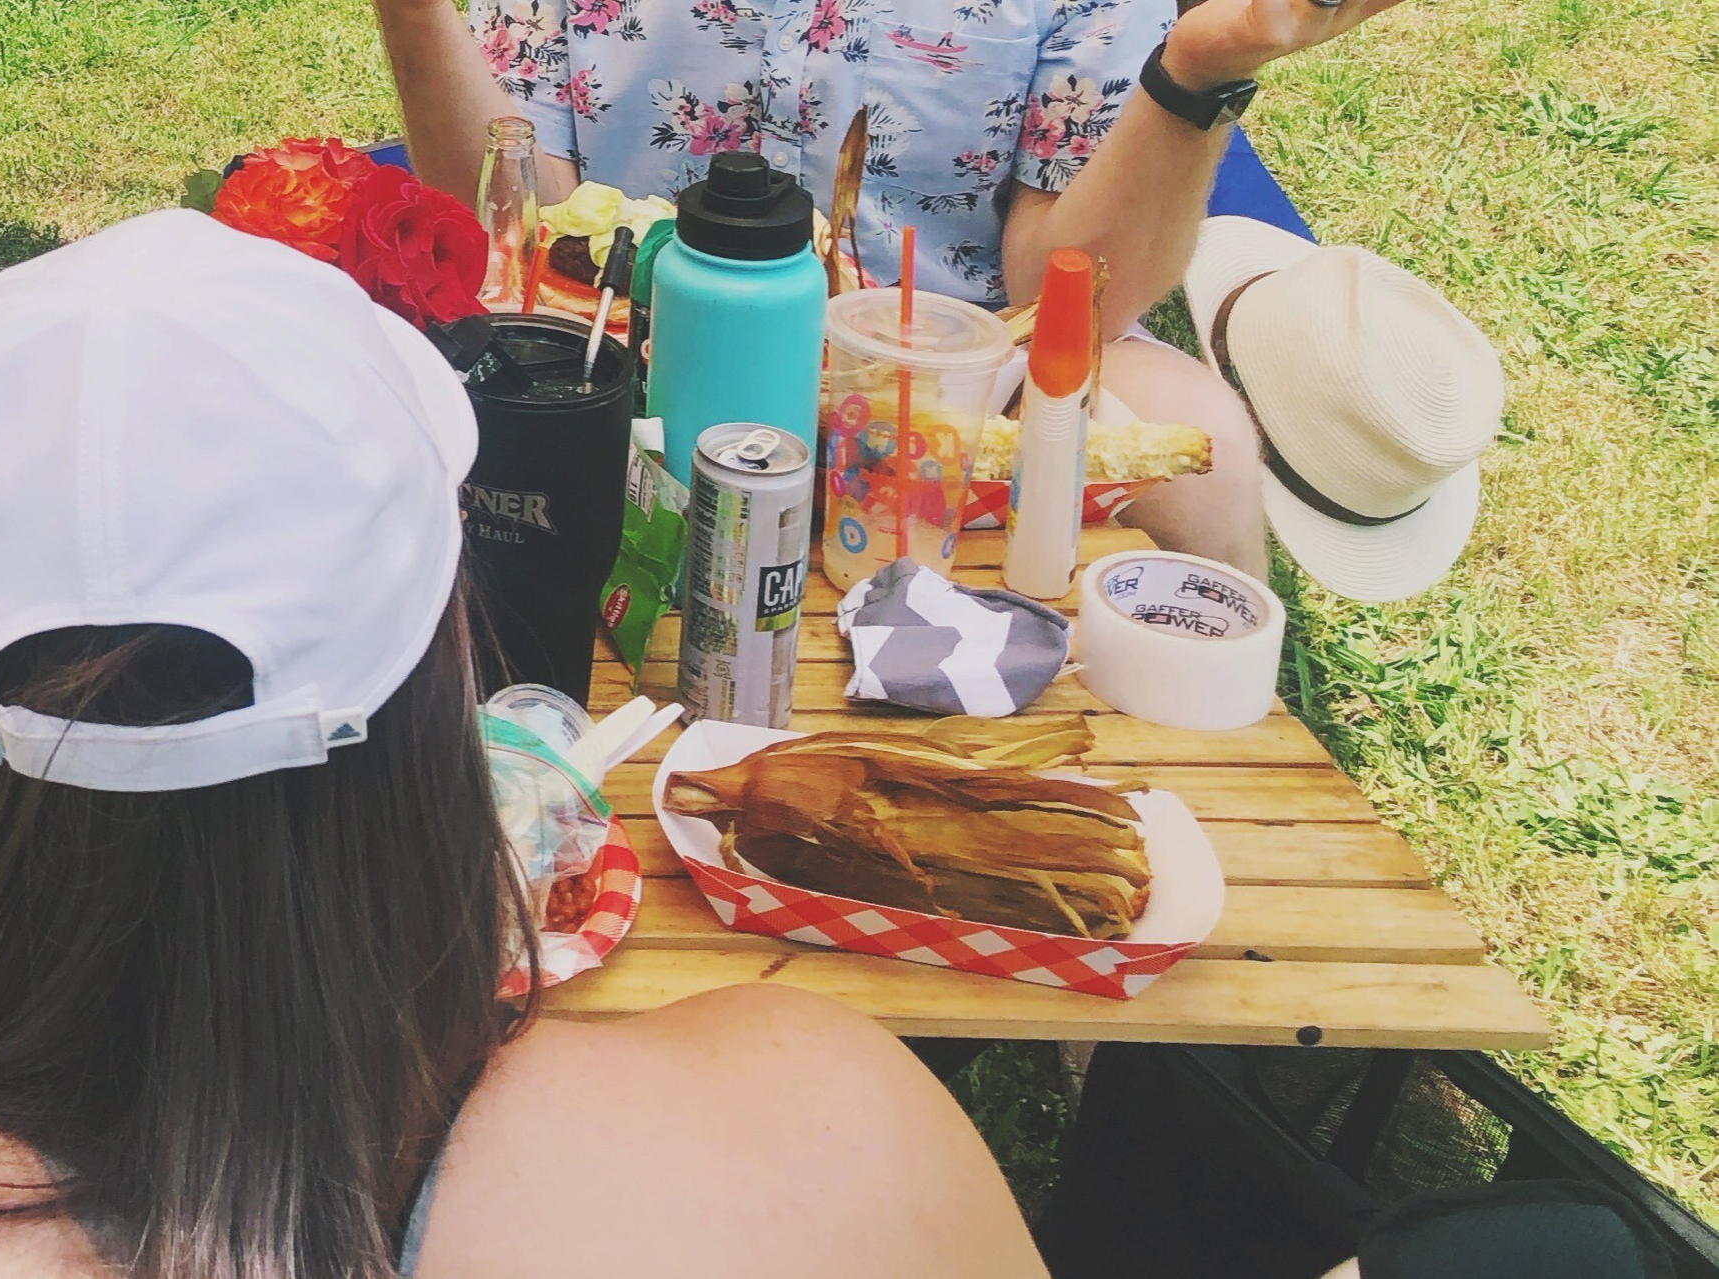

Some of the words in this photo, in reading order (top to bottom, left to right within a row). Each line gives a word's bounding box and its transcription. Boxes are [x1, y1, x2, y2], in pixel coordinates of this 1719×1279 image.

[478, 523, 525, 544] HAUL
[1188, 573, 1247, 603] GAFFER
[607, 587, 629, 629] Skittles
[1135, 604, 1201, 620] GAFFER
[1131, 613, 1225, 638] POWER
